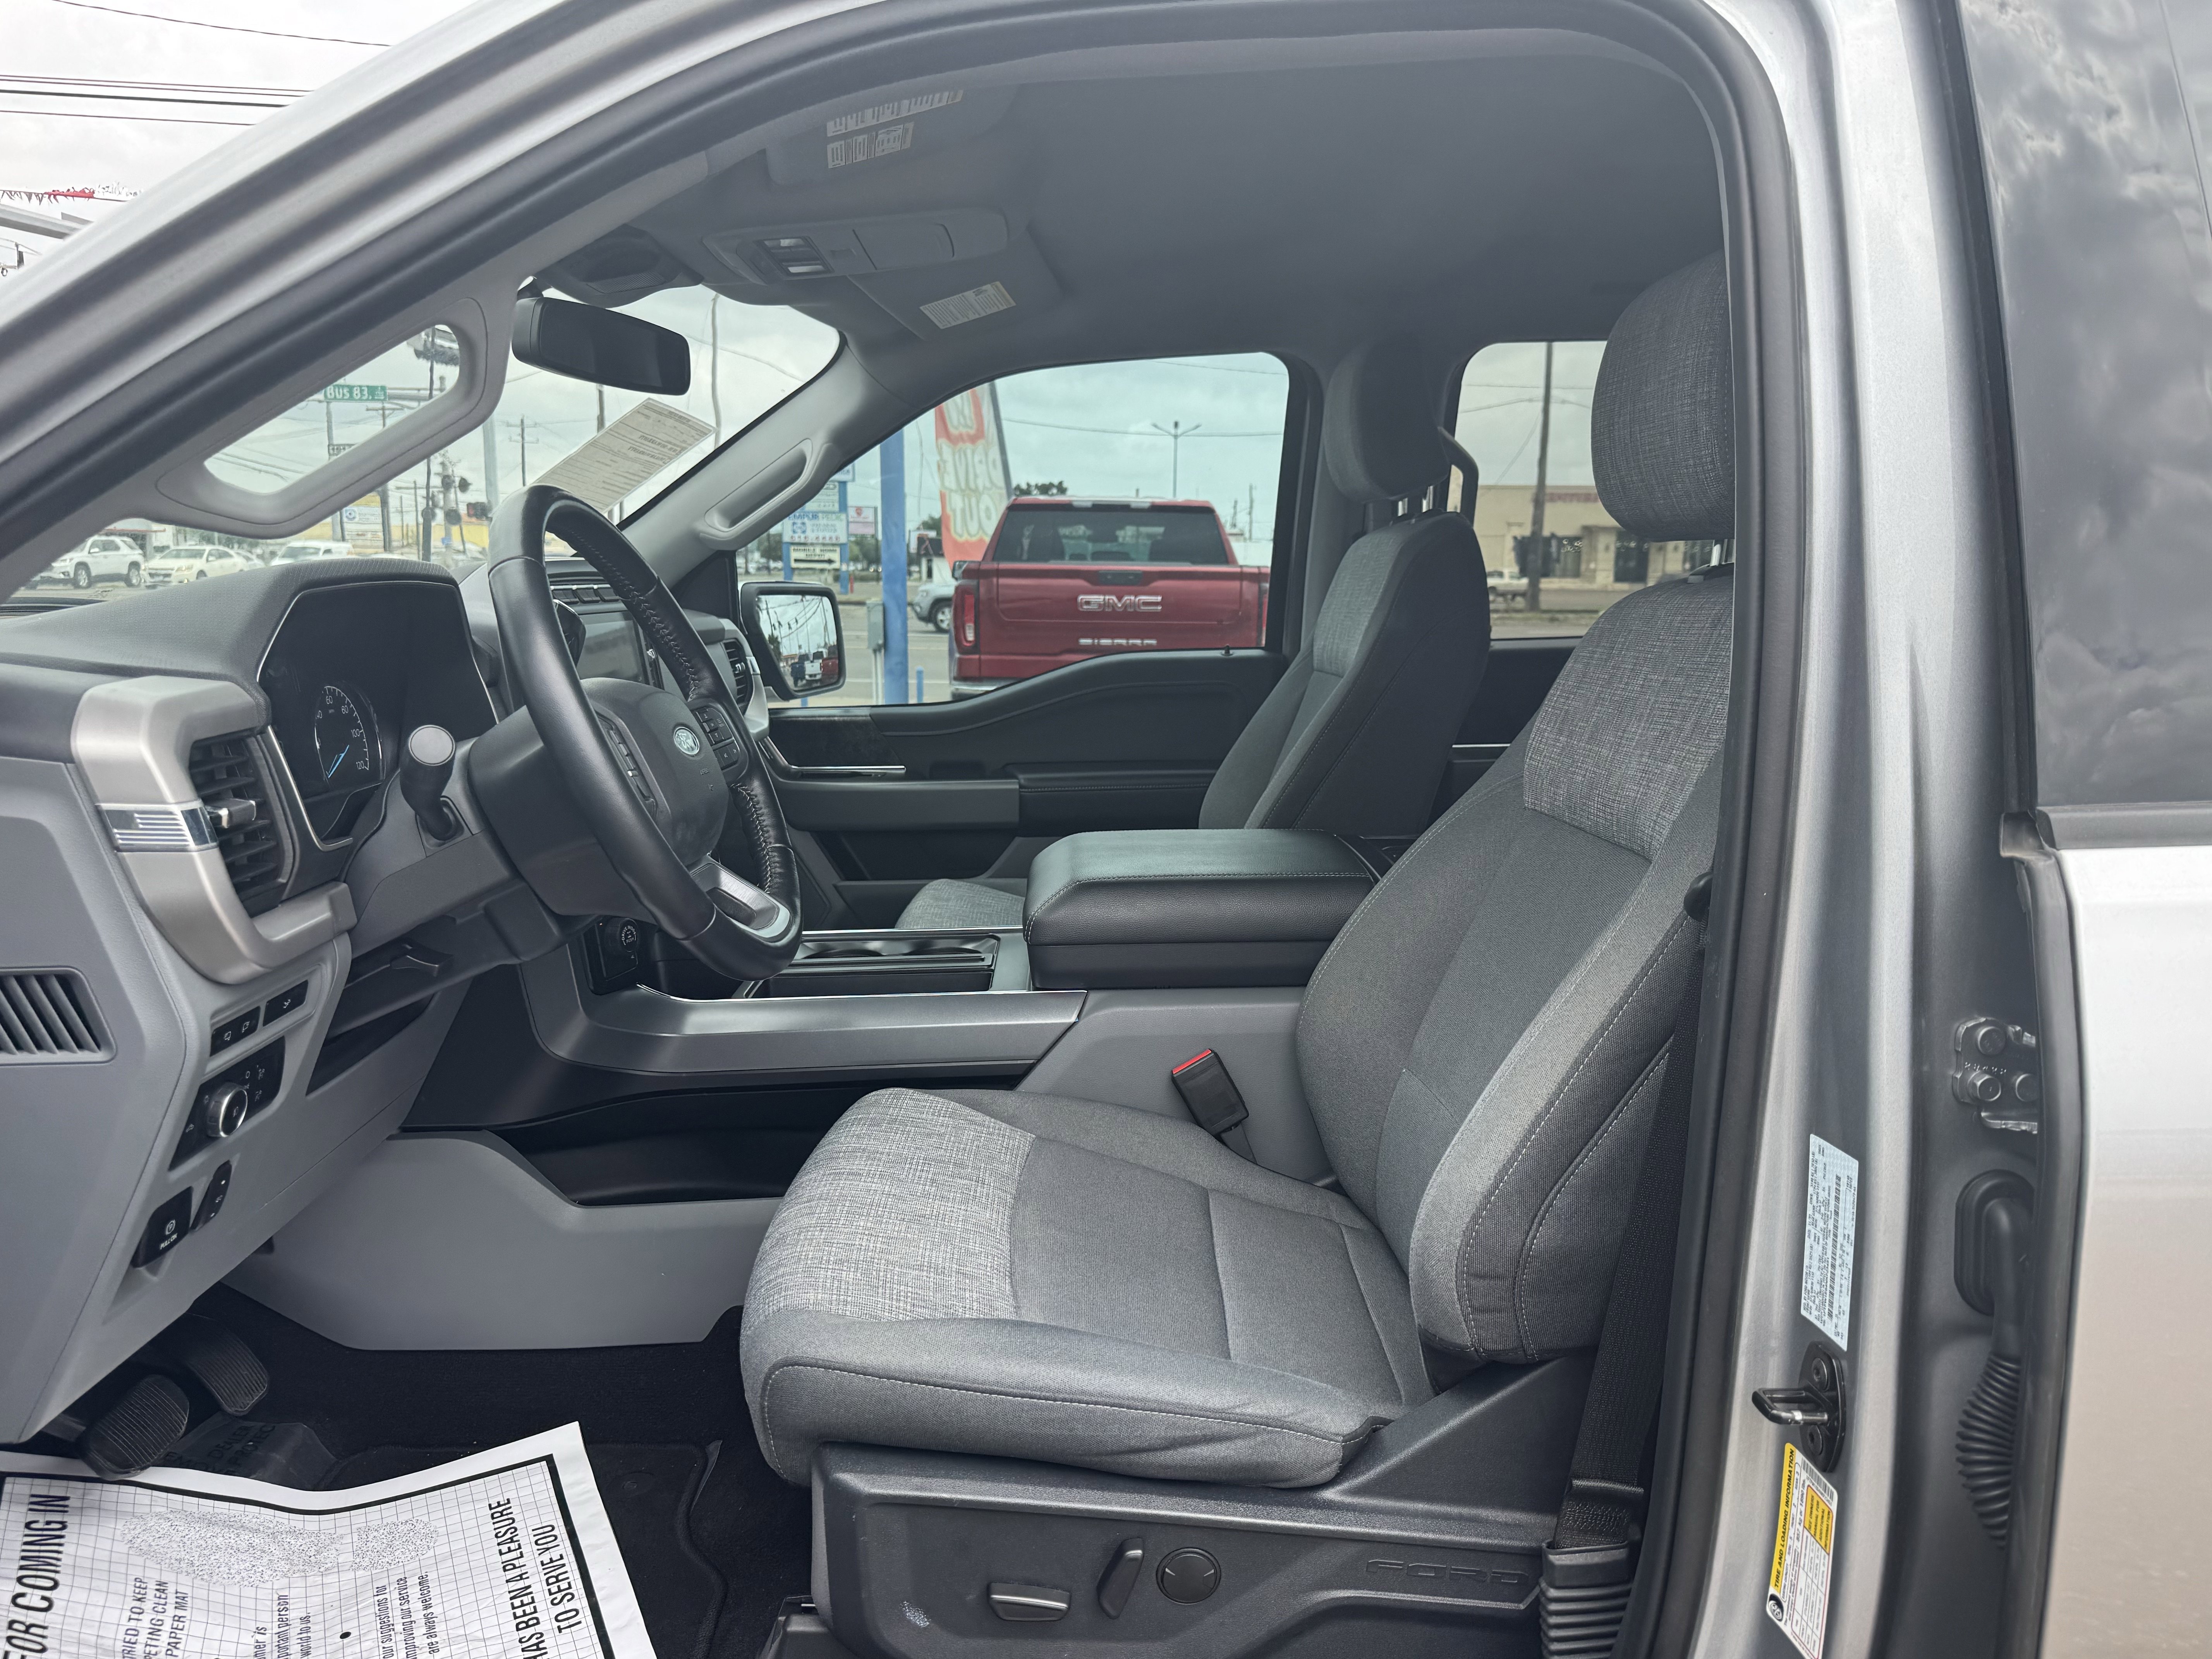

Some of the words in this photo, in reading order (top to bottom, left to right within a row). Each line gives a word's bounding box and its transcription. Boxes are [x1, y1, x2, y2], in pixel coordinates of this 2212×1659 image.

[327, 386, 349, 399] BUS
[1077, 594, 1162, 612] GMC
[326, 696, 333, 704] 60
[351, 729, 361, 738] 100
[356, 760, 365, 770] 120
[28, 1494, 71, 1513] IN
[1780, 1509, 1789, 1549] LOADING
[1785, 1448, 1795, 1509] INFORMATION
[488, 1498, 527, 1572] PLEASURE
[532, 1524, 560, 1556] YOU
[11, 1520, 68, 1613] COMING
[505, 1571, 530, 1583] A
[132, 1577, 148, 1603] KEEP
[373, 1585, 387, 1597] for
[395, 1577, 409, 1606] service
[417, 1571, 432, 1611] welcome.
[540, 1553, 575, 1606] SERVE
[152, 1580, 169, 1614] CLEAN
[175, 1590, 189, 1611] MAT
[508, 1584, 541, 1632] BEEN
[128, 1606, 145, 1623] TO
[276, 1594, 290, 1628] person
[300, 1612, 311, 1625] us.
[375, 1597, 395, 1644] suggestions
[401, 1607, 413, 1620] our
[554, 1608, 582, 1634] TO
[165, 1614, 187, 1657] PAPER
[255, 1626, 267, 1636] is
[300, 1625, 312, 1634] to
[422, 1611, 438, 1640] always
[300, 1635, 312, 1659] world
[428, 1640, 441, 1655] are
